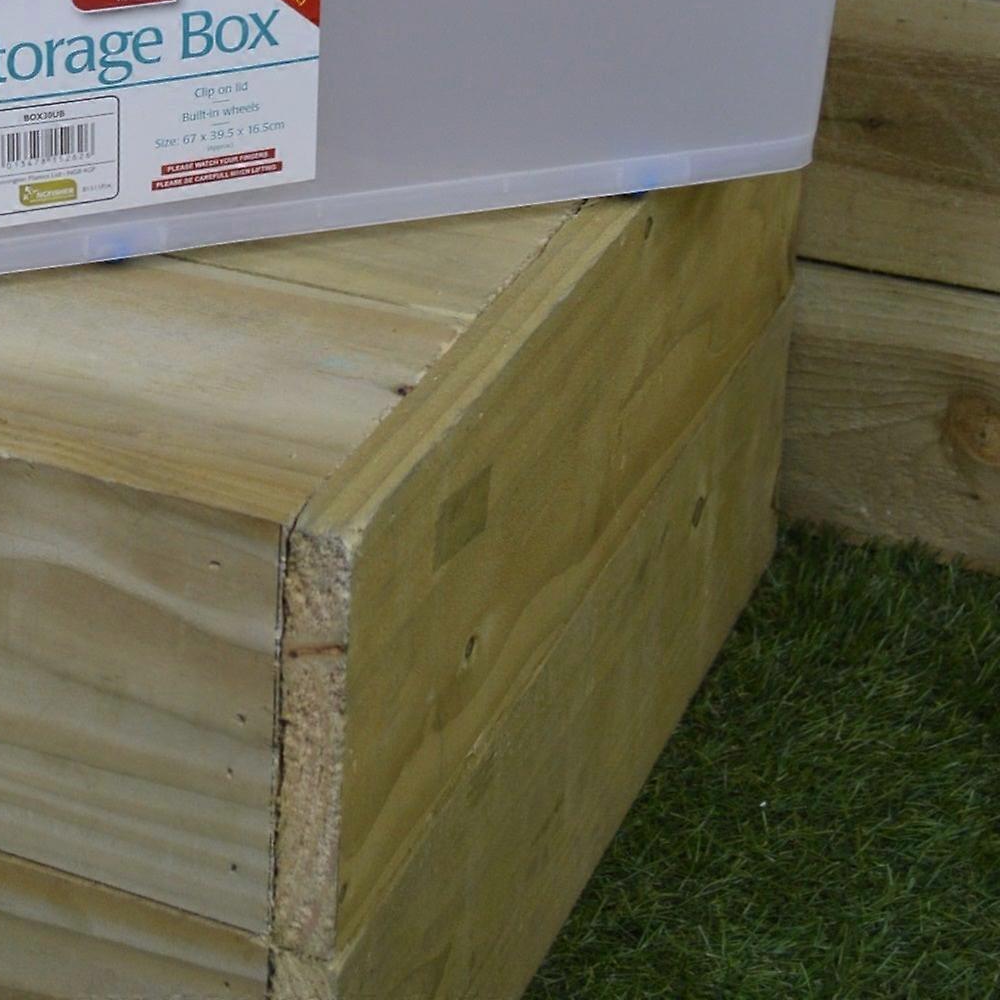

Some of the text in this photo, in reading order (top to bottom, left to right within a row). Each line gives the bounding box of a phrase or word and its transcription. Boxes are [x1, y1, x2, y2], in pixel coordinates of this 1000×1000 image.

[181, 9, 280, 60] Box
[194, 81, 248, 98] Clip on lid
[182, 102, 260, 122] Built-in wheels
[154, 120, 285, 149] Size: 67 x 39.5 x 16.5cm
[167, 161, 194, 172] PLEASE
[195, 158, 219, 168] WATCH
[156, 177, 182, 188] PLEASE
